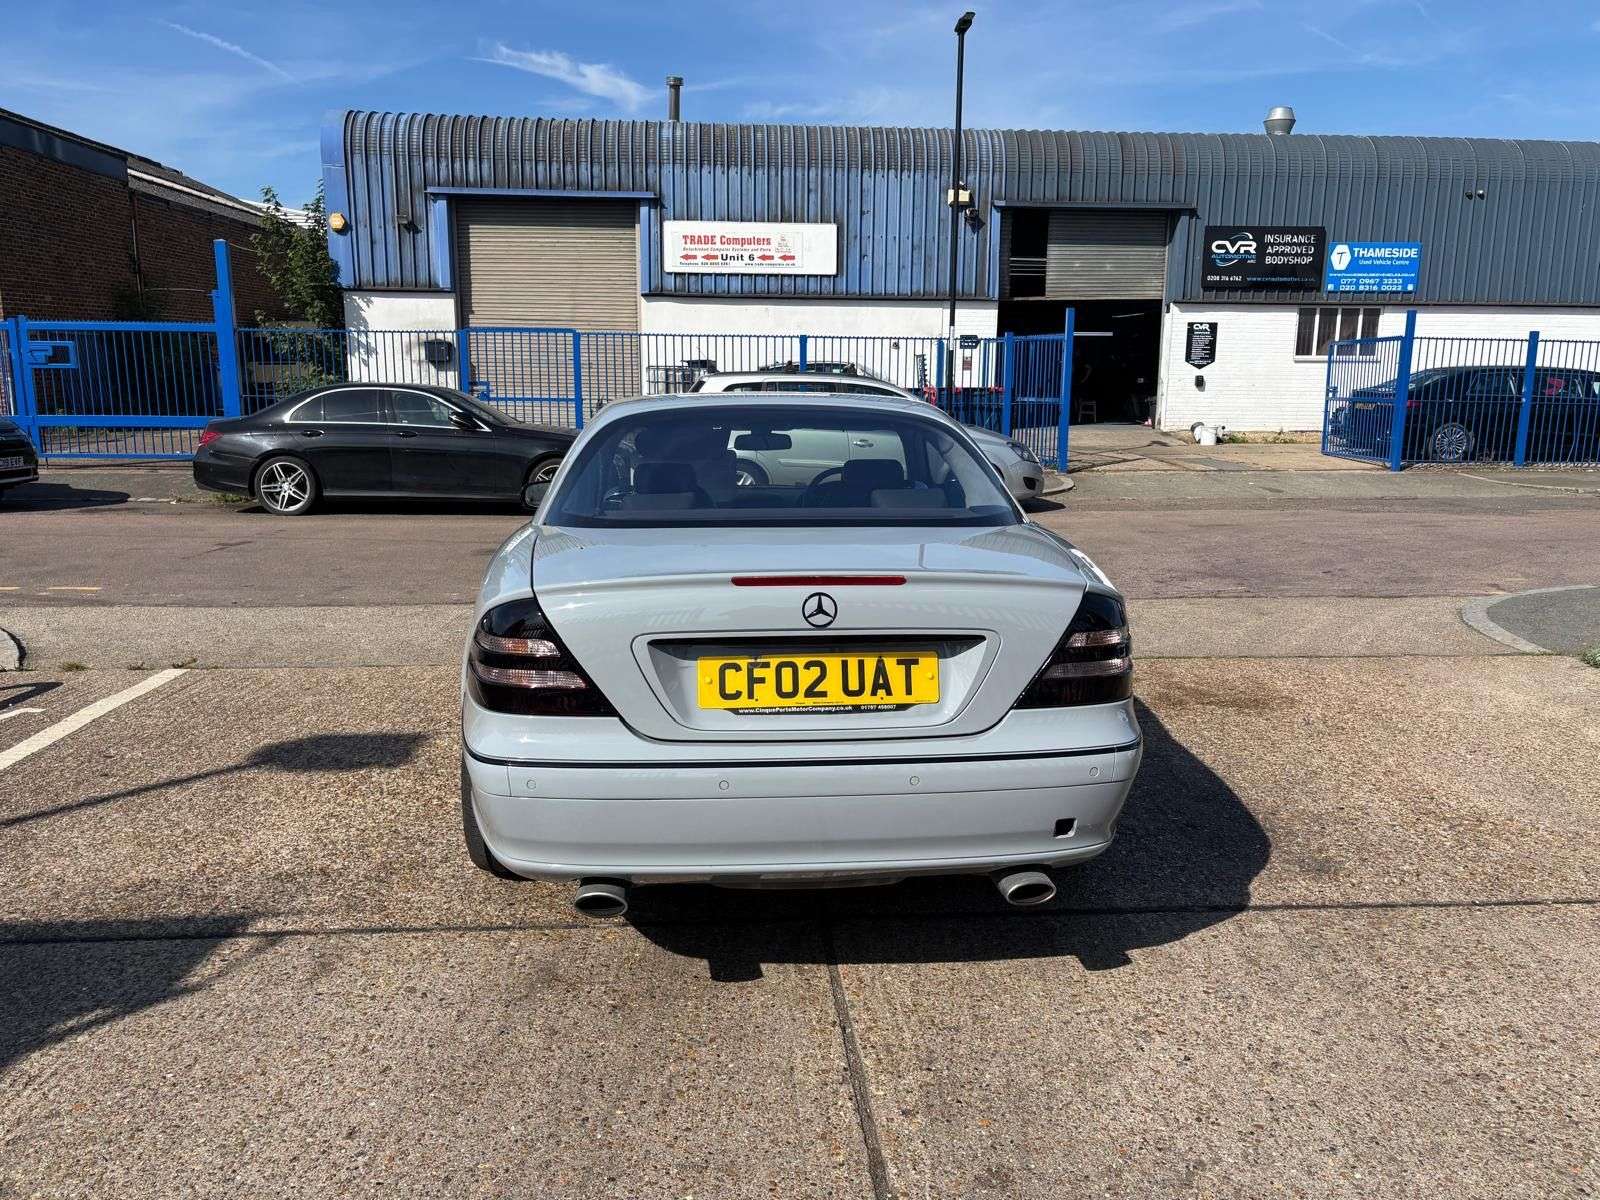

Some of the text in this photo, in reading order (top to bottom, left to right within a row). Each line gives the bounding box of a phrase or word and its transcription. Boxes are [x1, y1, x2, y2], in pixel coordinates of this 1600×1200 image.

[682, 235, 716, 245] TRADE
[719, 235, 772, 247] Computers
[1264, 234, 1317, 243] INSURANCE
[1211, 240, 1257, 253] CVR
[1266, 245, 1315, 254] APPROVED
[720, 253, 745, 261] Unit
[1336, 251, 1347, 265] T
[1353, 247, 1419, 258] THAMESIDE
[1265, 255, 1313, 264] BODYSHOP
[718, 658, 919, 700] CF02 UAT
